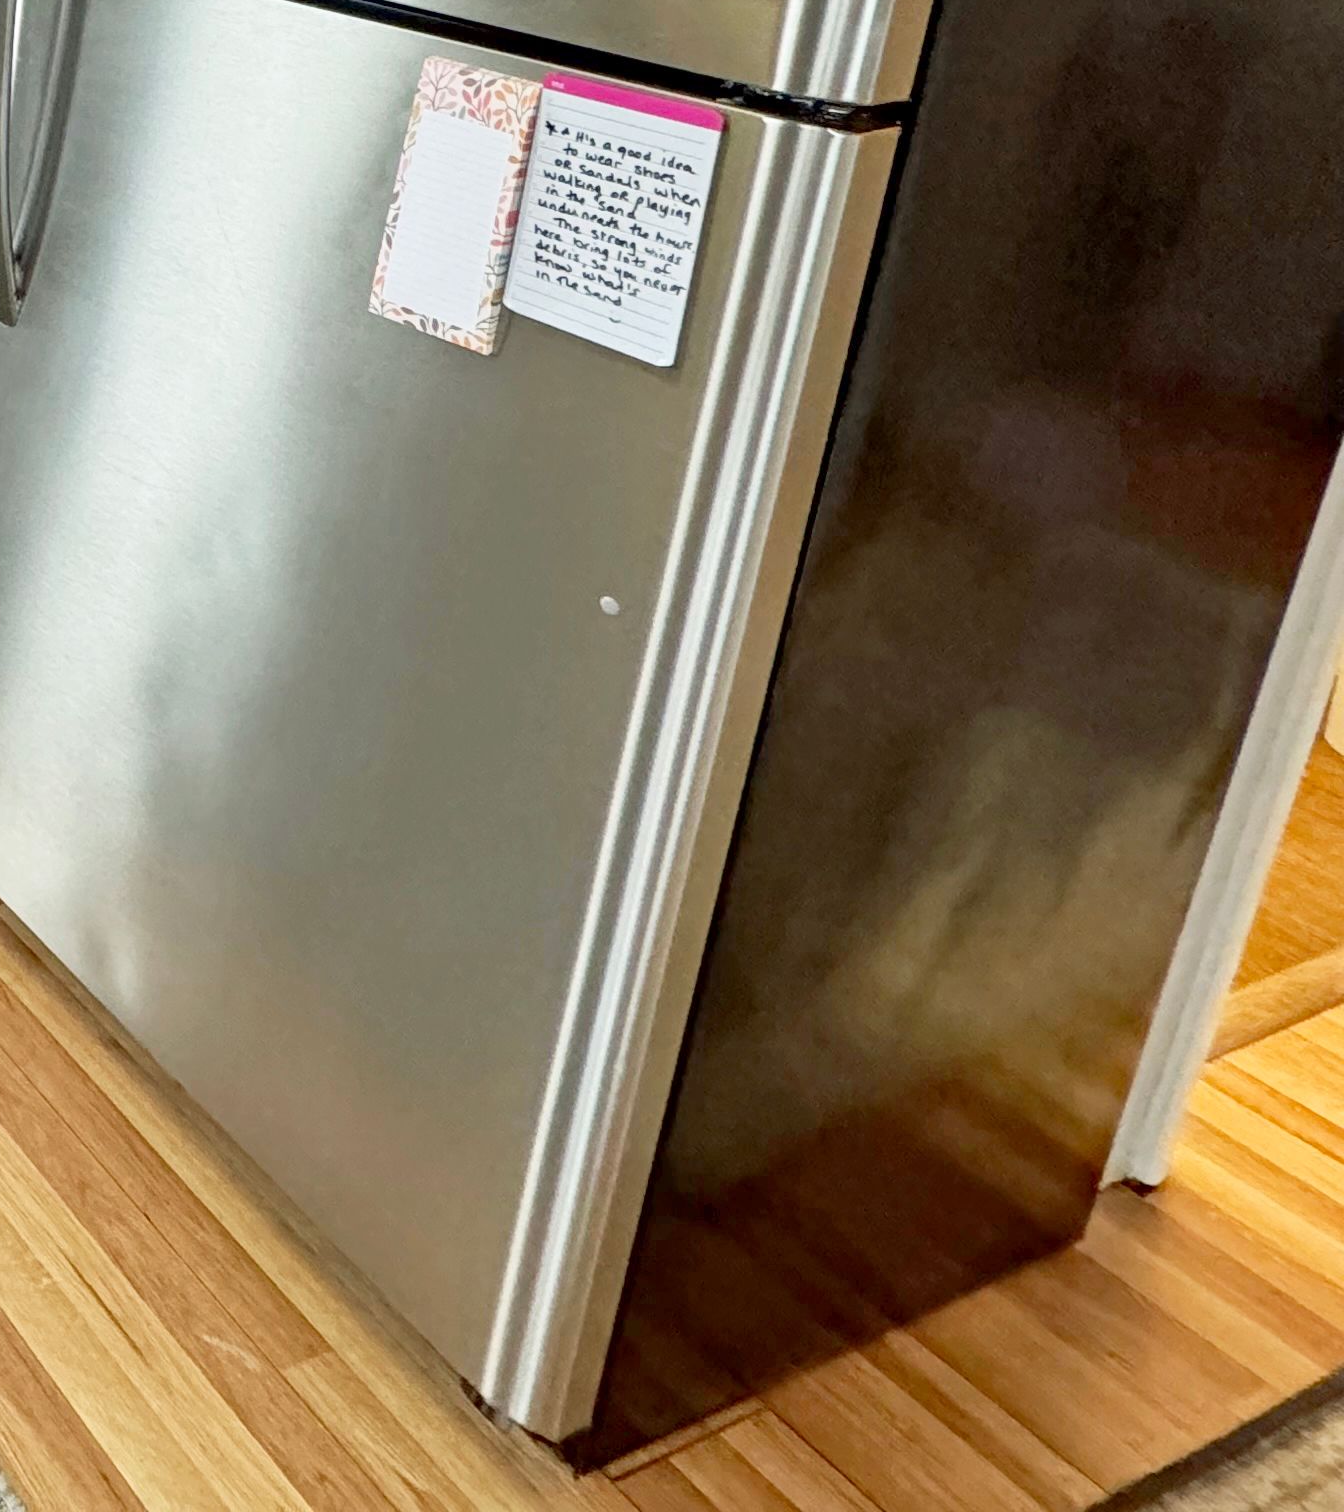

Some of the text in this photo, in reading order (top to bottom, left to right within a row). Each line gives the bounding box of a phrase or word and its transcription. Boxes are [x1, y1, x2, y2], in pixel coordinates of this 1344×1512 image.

[563, 143, 676, 184] to wear shoes
[603, 142, 612, 151] a
[617, 146, 652, 159] good
[661, 155, 696, 176] idea
[543, 169, 601, 201] walking
[632, 196, 691, 226] playing
[546, 184, 636, 220] in the sand
[579, 164, 641, 189] sandals
[654, 188, 701, 208] when
[534, 224, 673, 275] here bring lots of
[553, 217, 683, 265] The strong winds
[629, 223, 649, 239] the
[534, 252, 572, 273] know
[614, 266, 636, 282] you
[536, 270, 550, 282] in
[584, 287, 622, 307] sand
